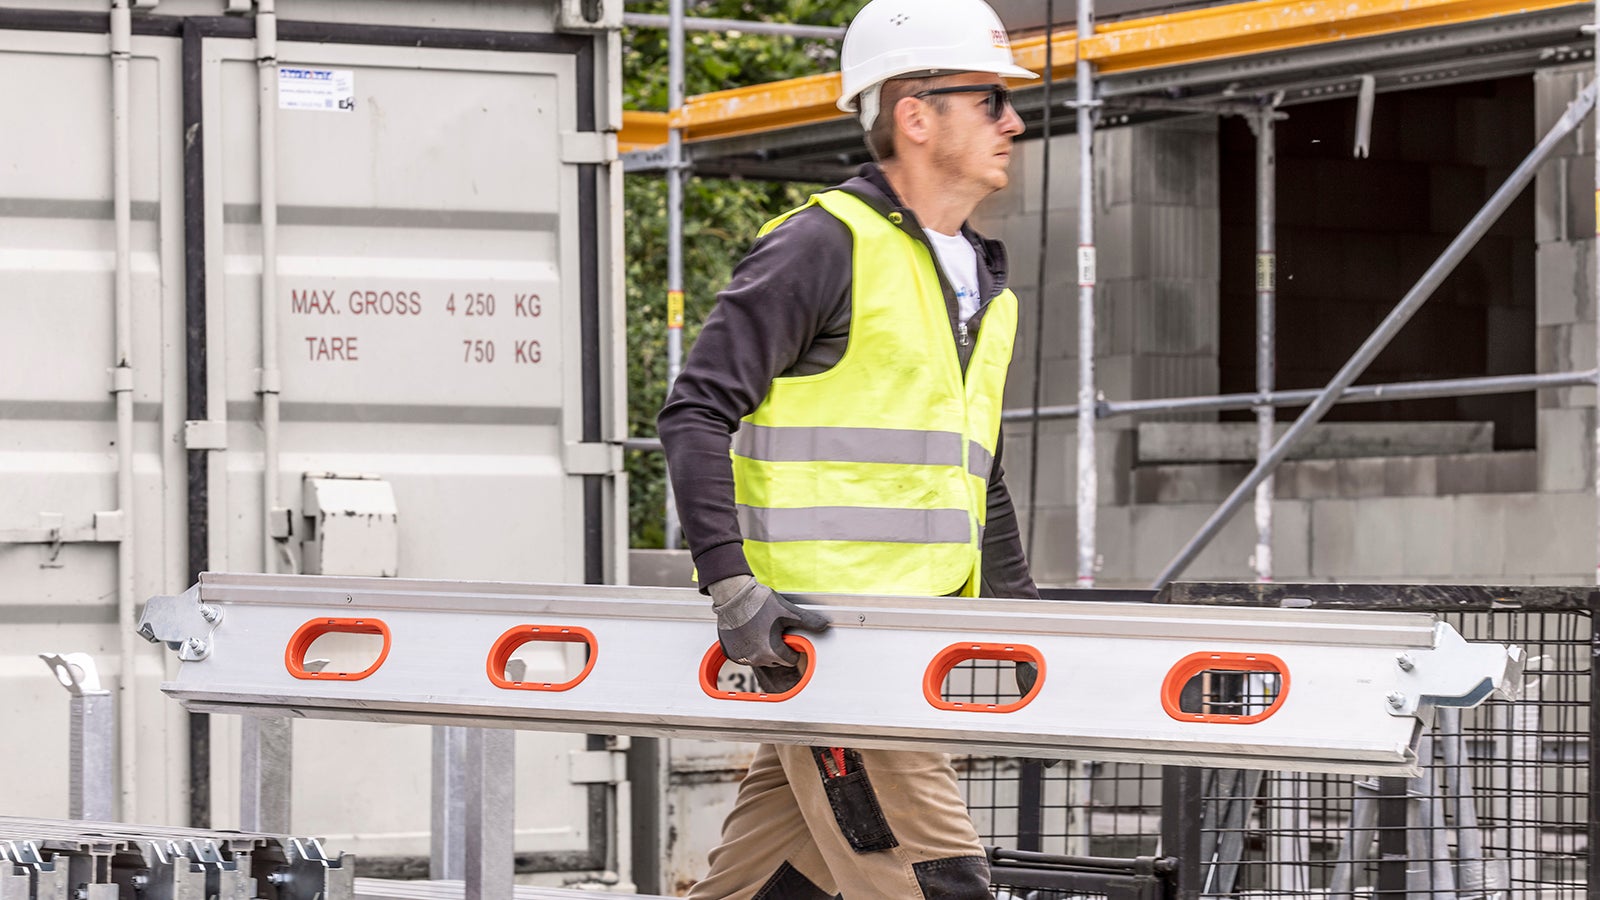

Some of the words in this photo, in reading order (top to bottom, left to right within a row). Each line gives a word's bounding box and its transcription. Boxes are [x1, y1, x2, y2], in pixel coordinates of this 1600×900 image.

[291, 290, 342, 315] MAX.
[349, 291, 421, 316] GROSS
[445, 294, 456, 316] 4
[465, 294, 496, 317] 250
[514, 294, 541, 318] KG
[306, 337, 359, 361] TARE
[463, 340, 495, 363] 750
[514, 340, 541, 364] KG
